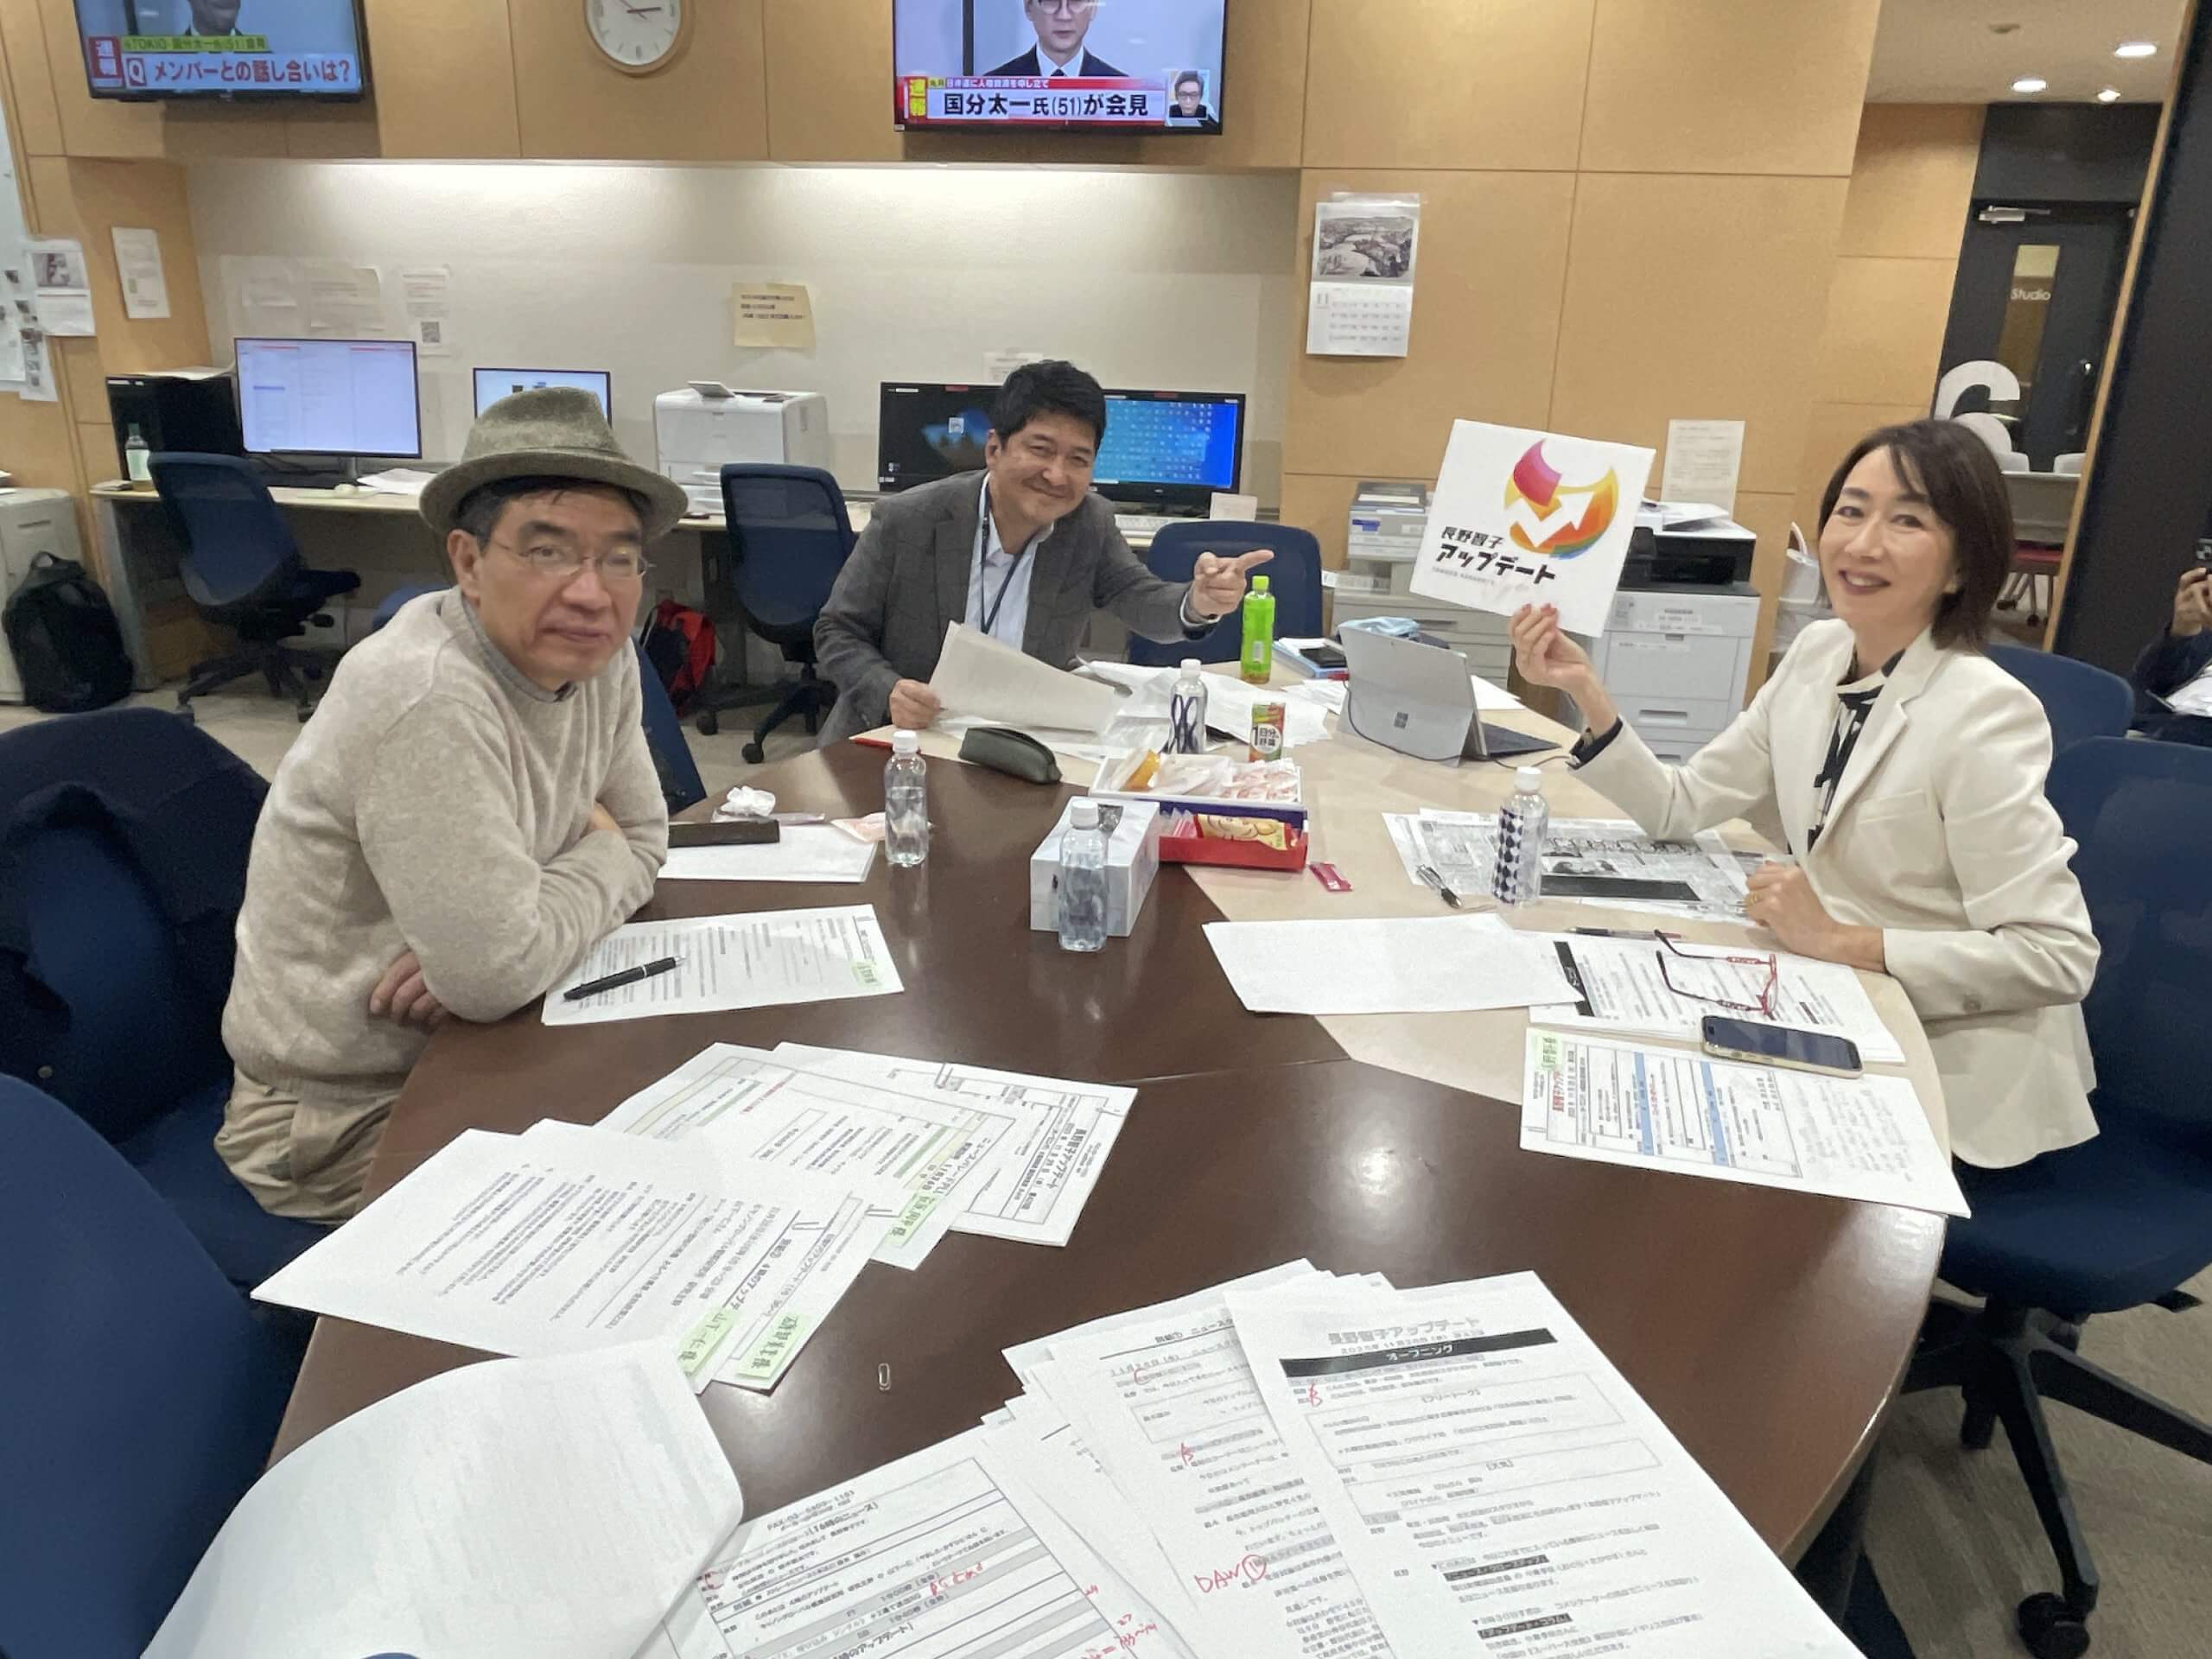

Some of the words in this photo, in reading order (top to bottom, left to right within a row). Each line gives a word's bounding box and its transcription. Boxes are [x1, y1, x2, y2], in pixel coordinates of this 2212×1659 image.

[944, 93, 1149, 117] 国分太一氏(51)が会見
[2011, 287, 2051, 302] Studio
[1440, 525, 1504, 550] 長野智子
[1435, 543, 1556, 585] アップデート
[1385, 1344, 1452, 1361] オープニング
